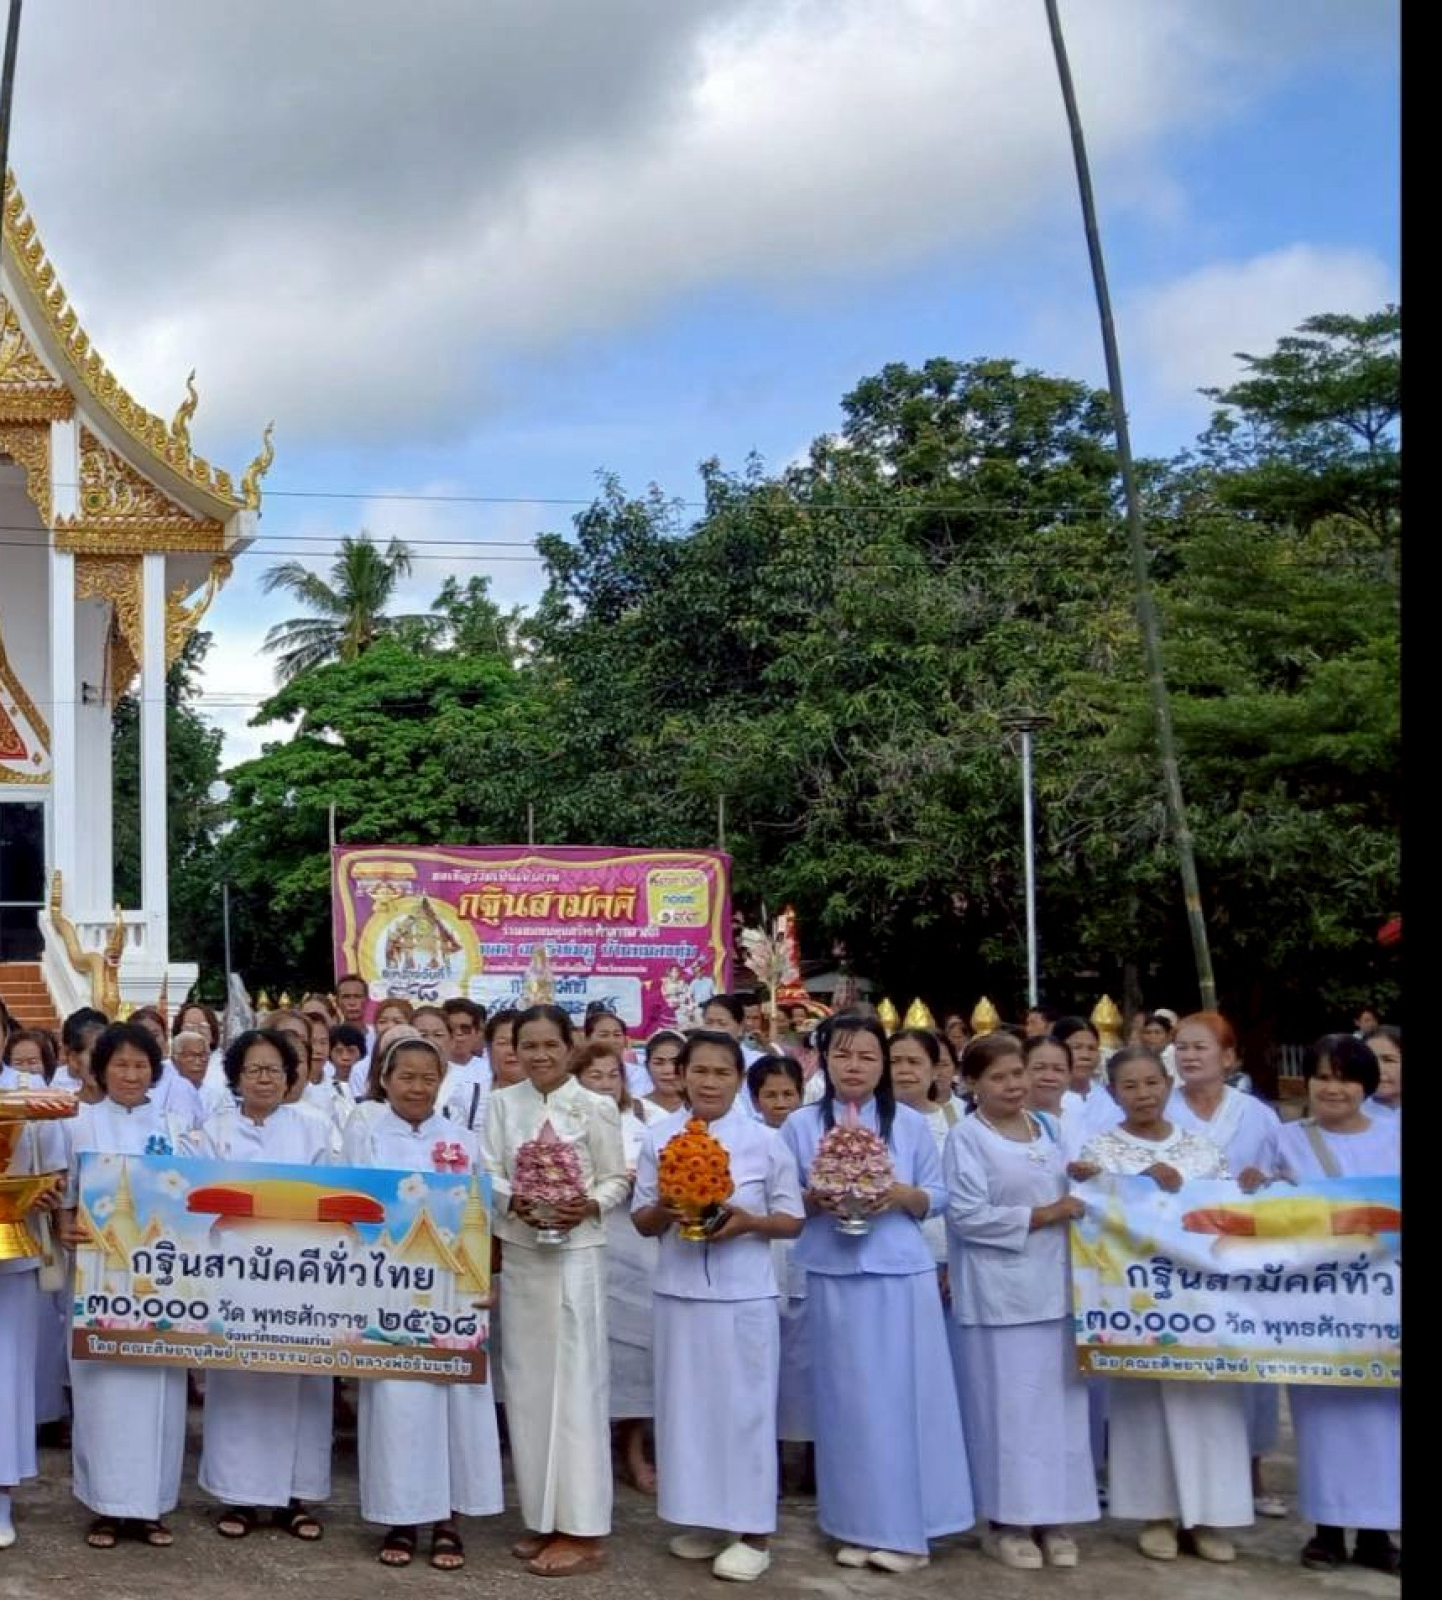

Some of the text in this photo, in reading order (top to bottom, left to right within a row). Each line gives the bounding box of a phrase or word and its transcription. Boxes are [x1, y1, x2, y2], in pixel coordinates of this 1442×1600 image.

[458, 886, 637, 926] กฐินสามัคคี
[132, 1238, 434, 1291] กฐินสามัคคีทั่วไทย
[1127, 1253, 1401, 1299] กฐินสามัคคีทั่ว
[87, 1293, 478, 1336] ๓๐,๐๐๐ วัด พุทธศักราช ๒๕๖๘
[1086, 1310, 1401, 1344] ๓๐,๐๐๐ วัด พุทธศักราช
